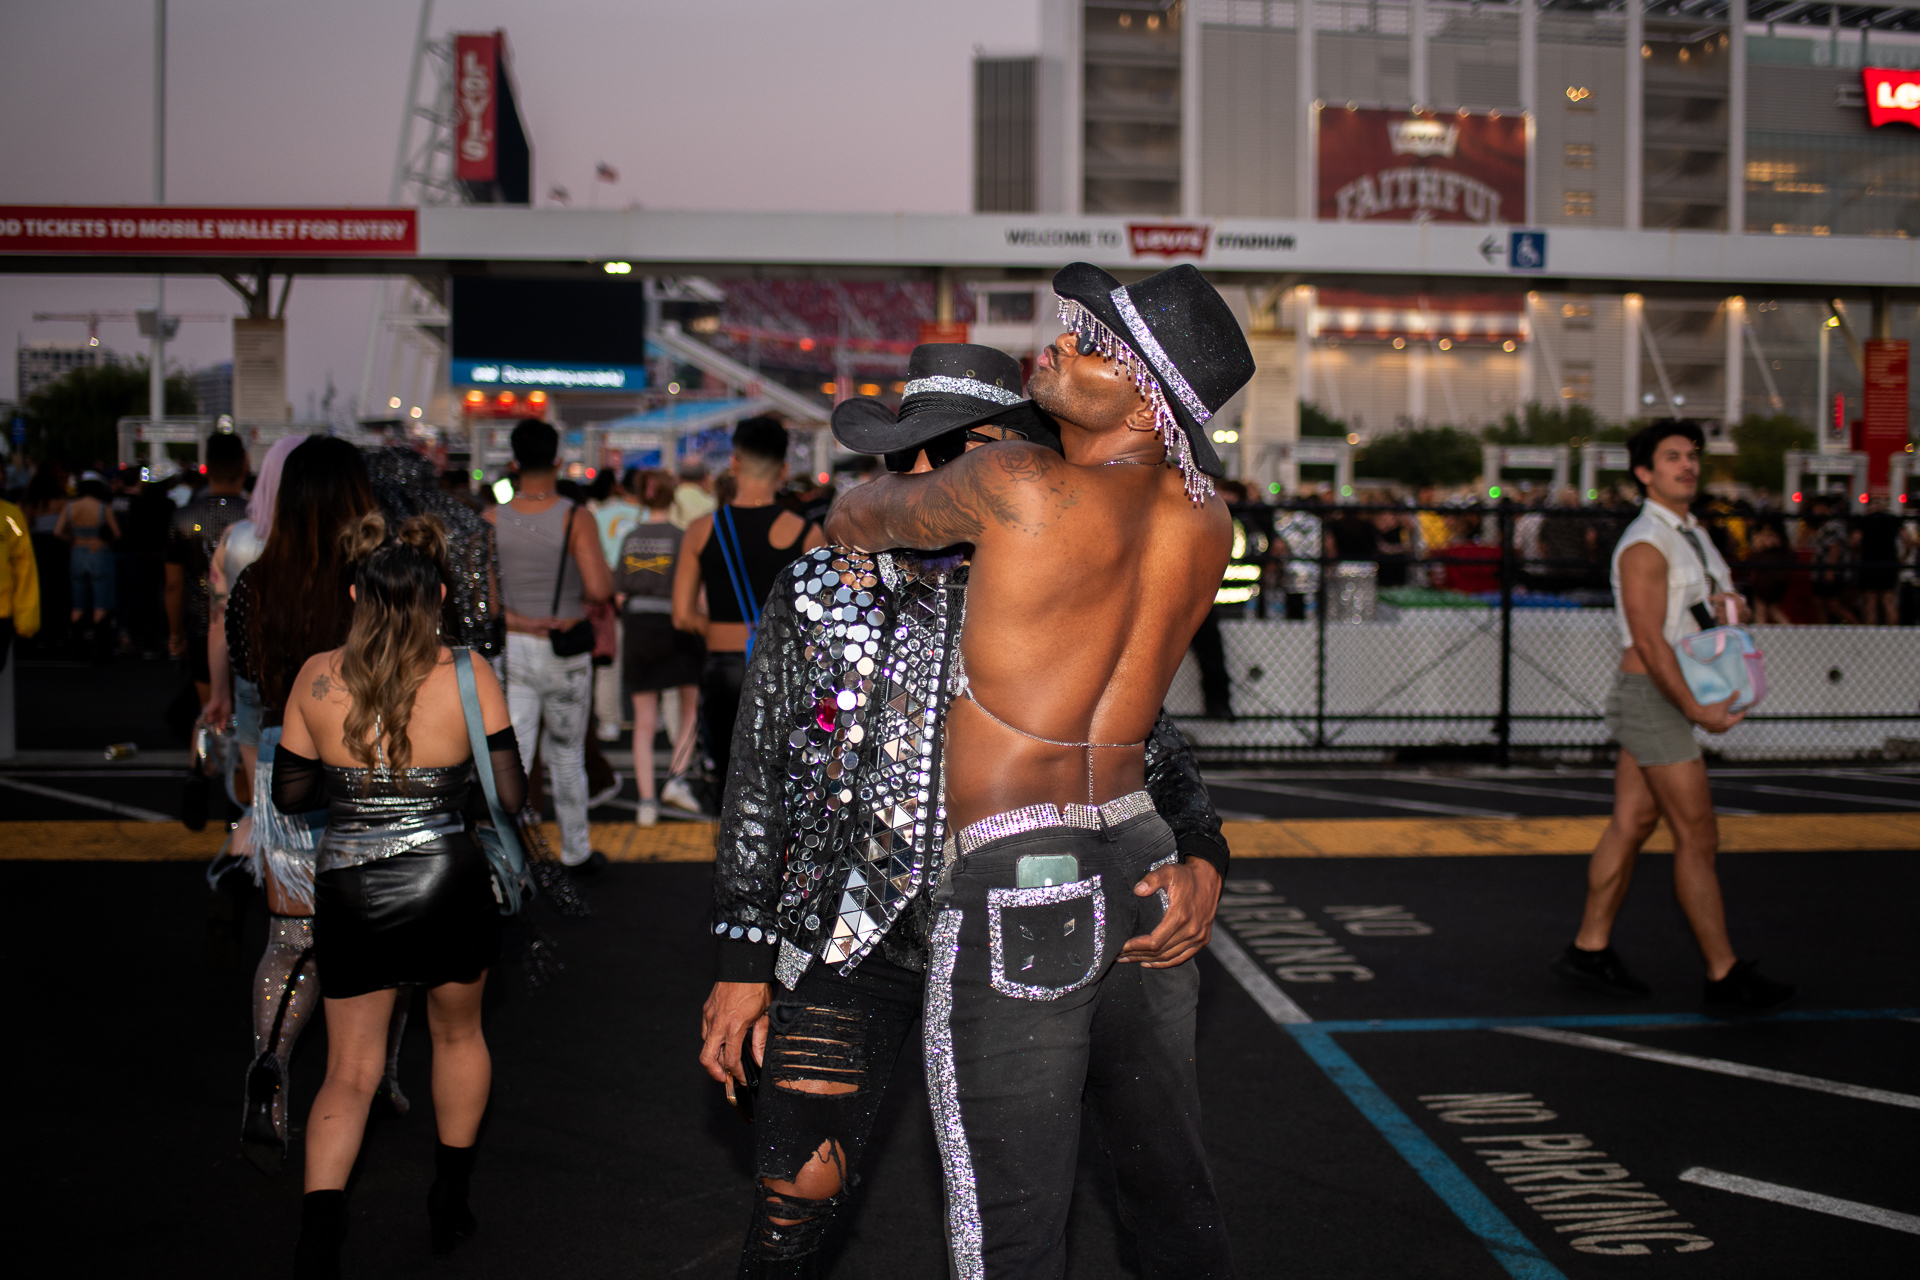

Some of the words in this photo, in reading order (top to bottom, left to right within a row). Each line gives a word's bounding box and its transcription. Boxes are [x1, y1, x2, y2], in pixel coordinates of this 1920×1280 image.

[23, 218, 107, 238] TICKETS
[109, 218, 138, 239] TO
[138, 219, 216, 240] MOBILE
[217, 219, 297, 240] WALLET
[299, 220, 341, 241] FOR
[342, 221, 407, 241] ENTRY
[1005, 228, 1092, 248] WELCOME
[1097, 229, 1123, 250] TO
[1215, 879, 1376, 983] PARKING
[1322, 904, 1435, 937] NO
[1416, 1092, 1559, 1125] NO
[1460, 1132, 1715, 1256] PARKING
